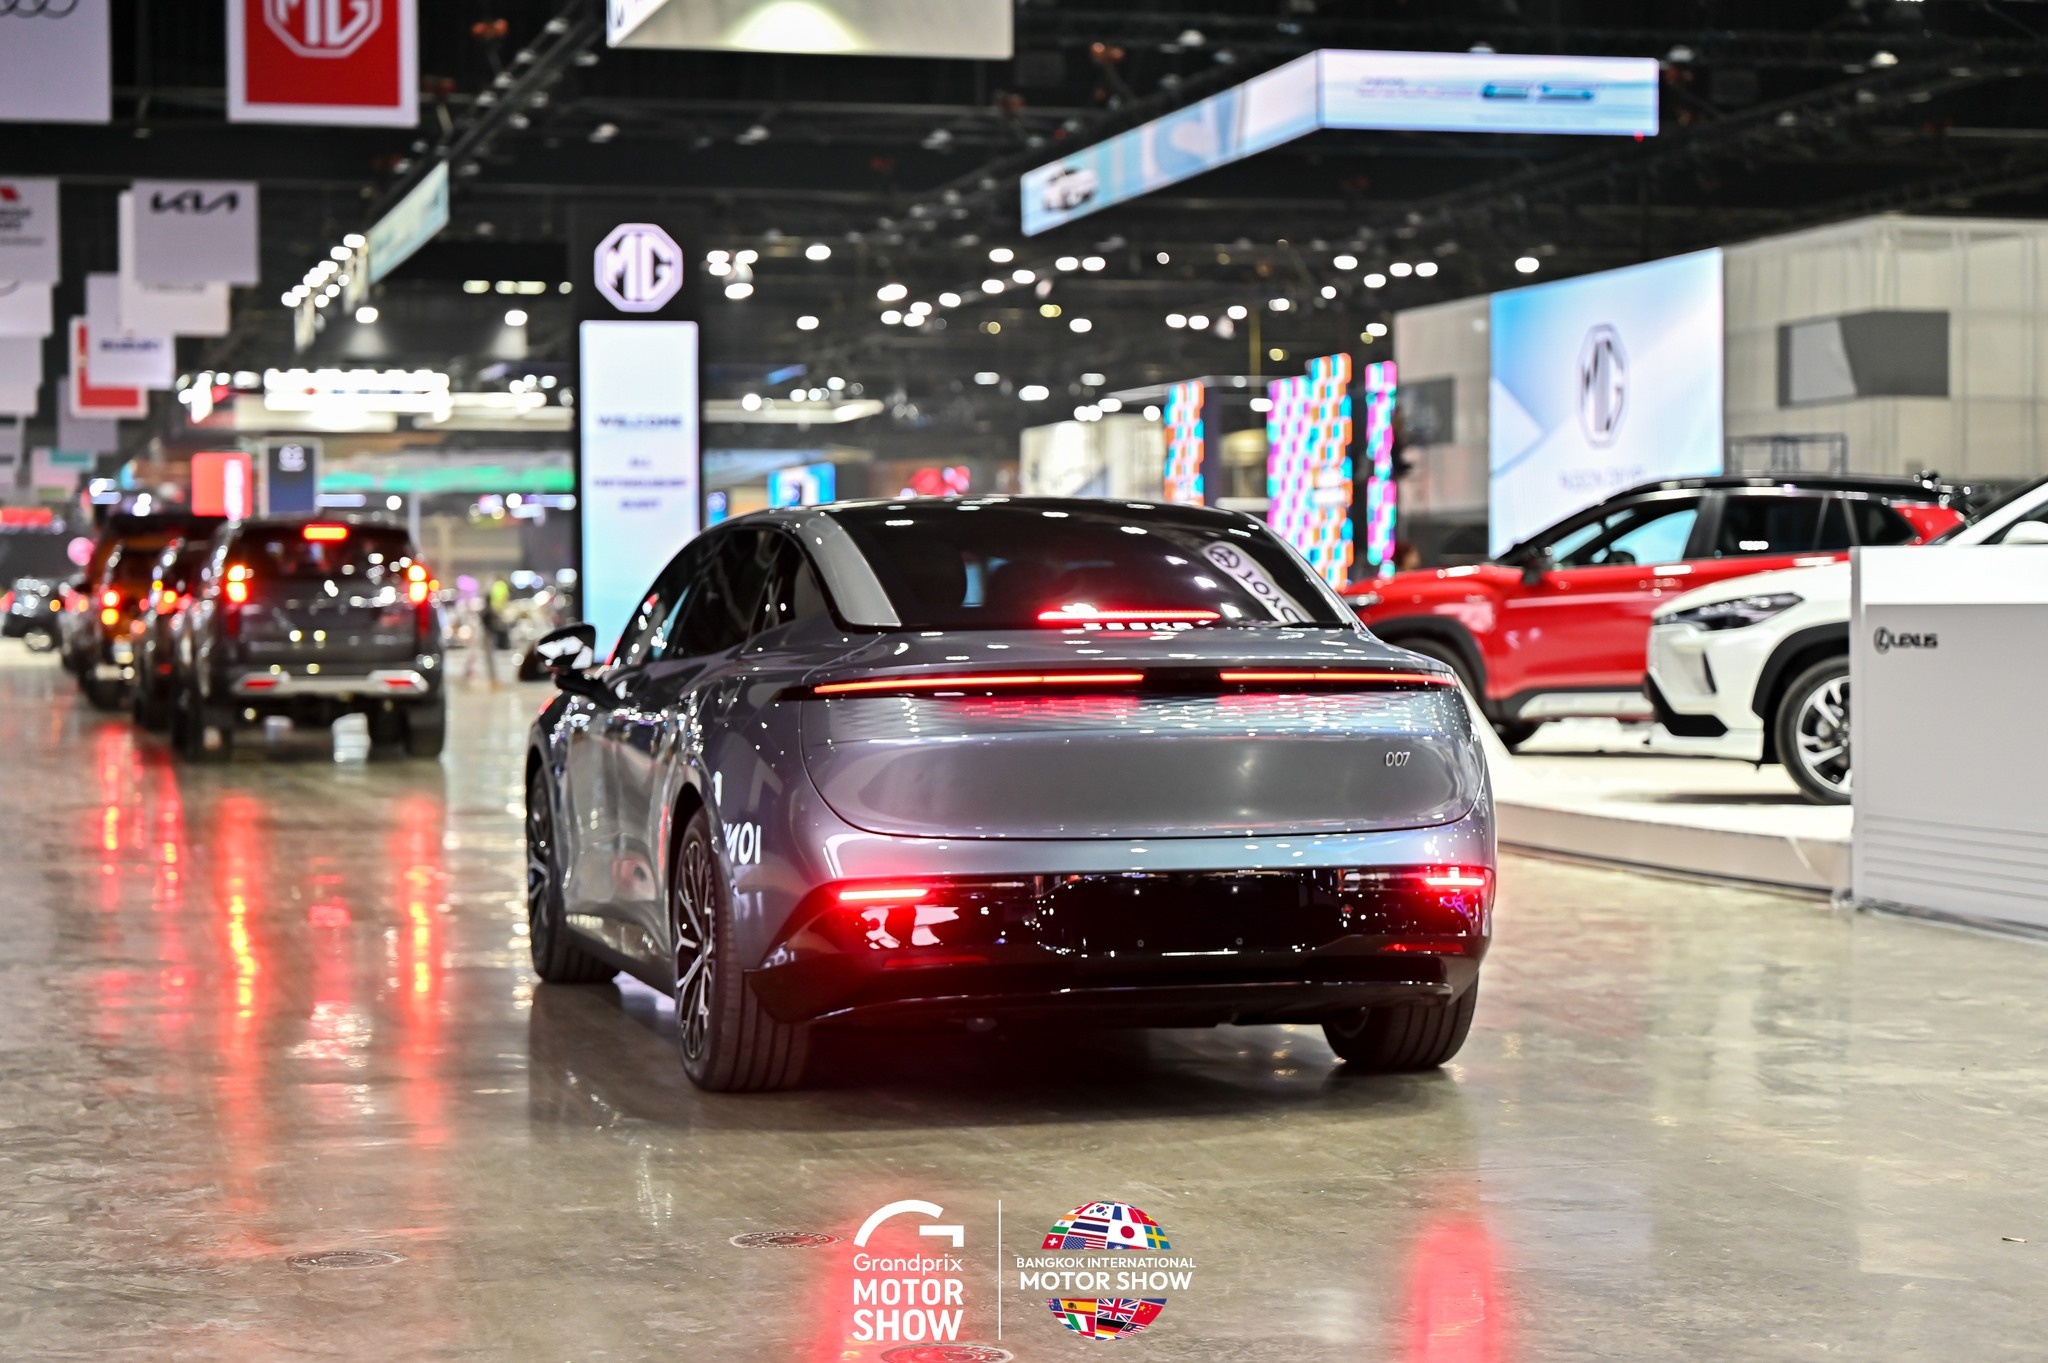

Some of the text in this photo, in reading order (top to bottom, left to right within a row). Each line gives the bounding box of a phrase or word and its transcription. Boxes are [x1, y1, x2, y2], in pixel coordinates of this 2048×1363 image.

[151, 190, 238, 215] KIA
[604, 231, 673, 302] MG
[1579, 339, 1625, 433] MG
[1384, 751, 1411, 767] 007
